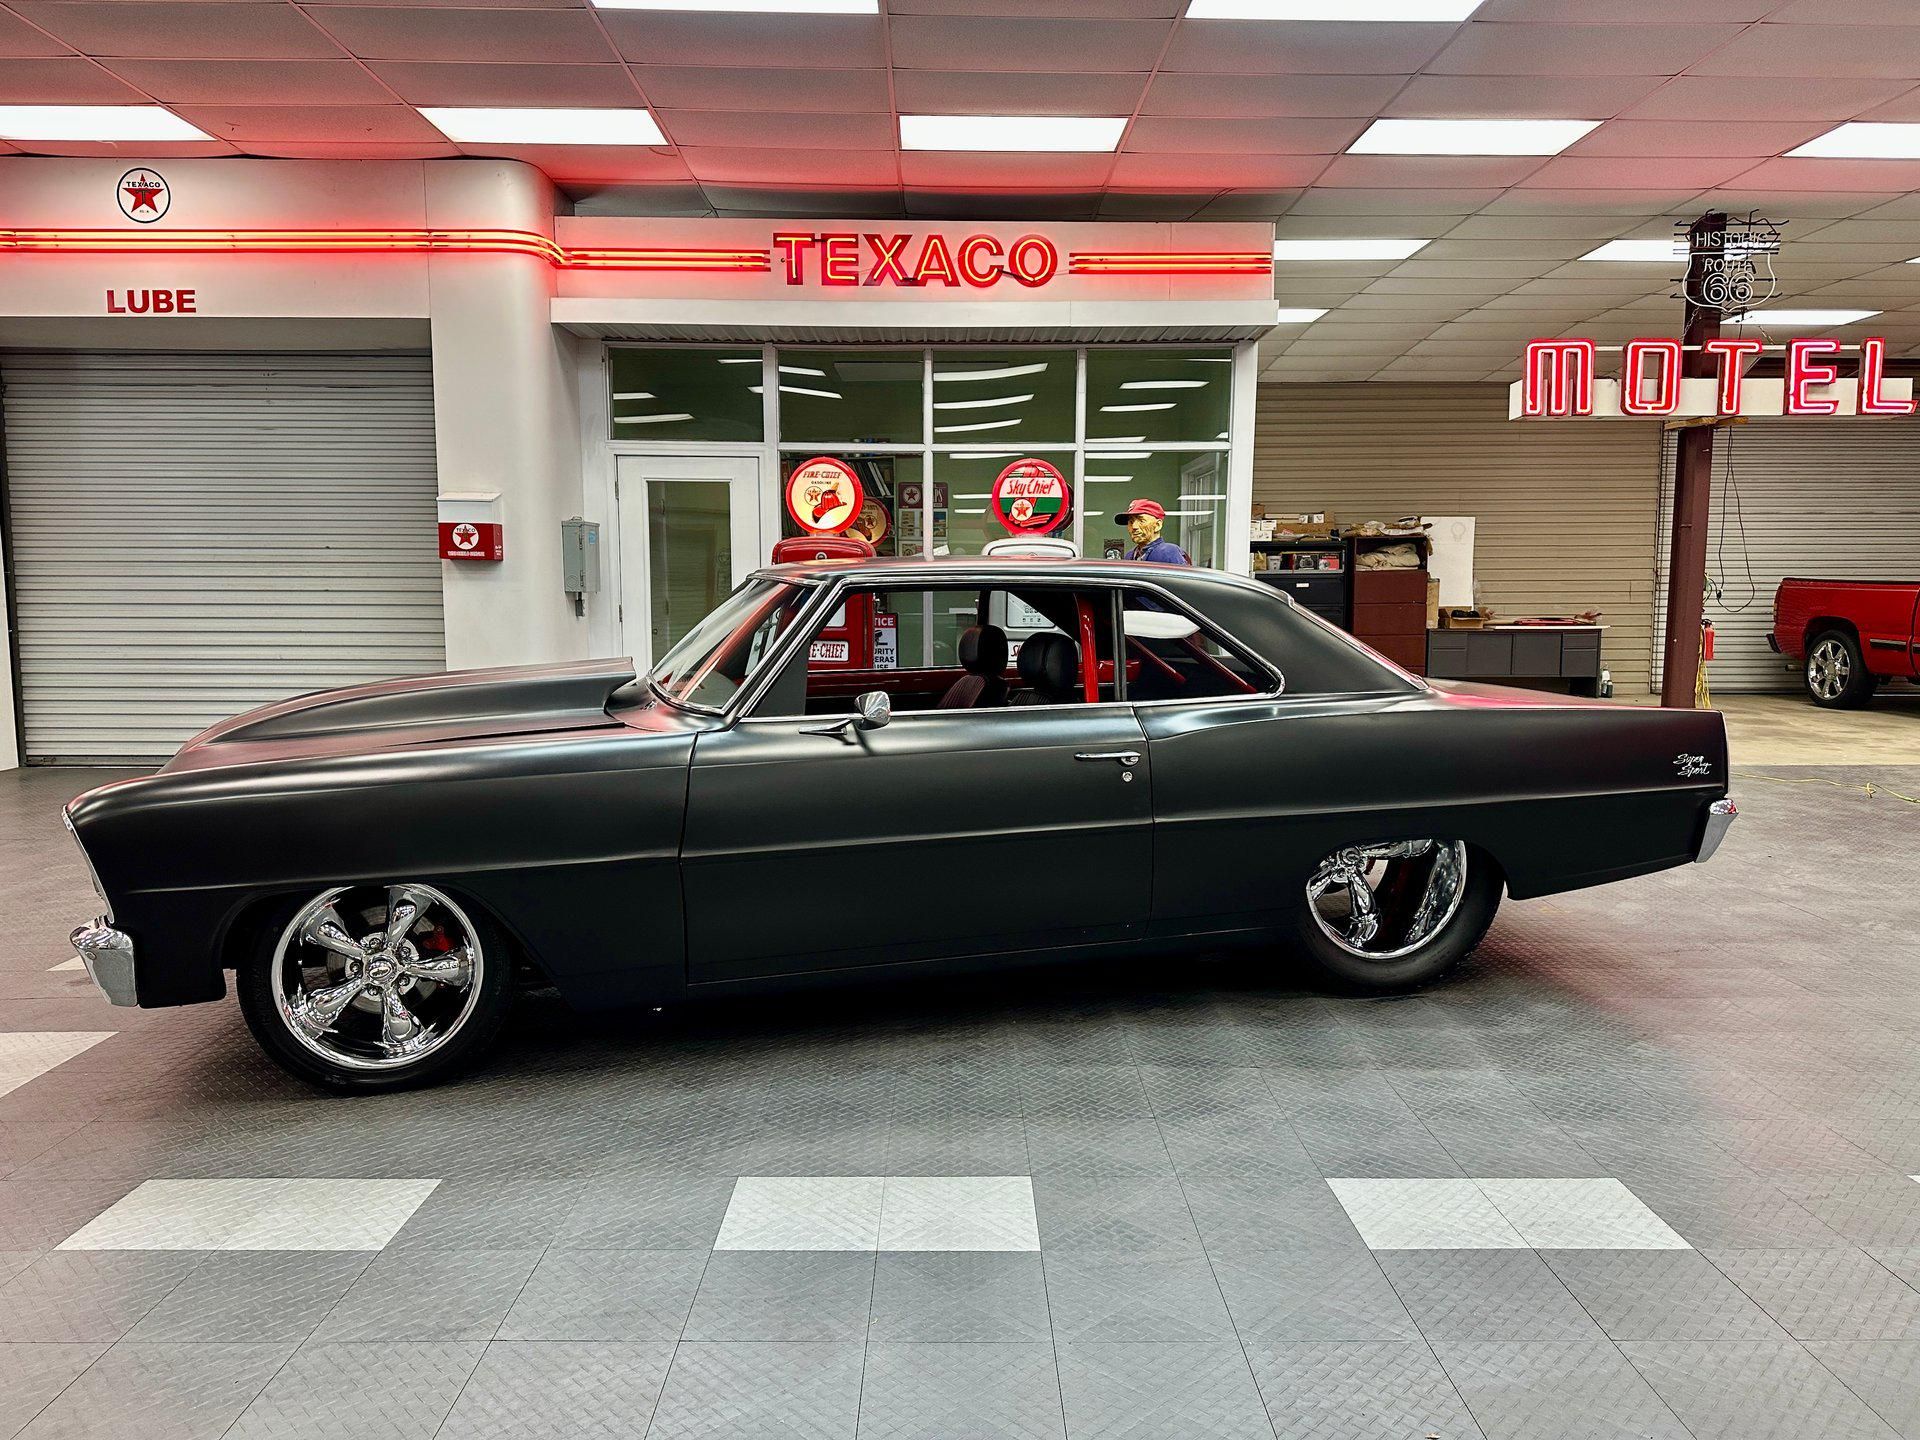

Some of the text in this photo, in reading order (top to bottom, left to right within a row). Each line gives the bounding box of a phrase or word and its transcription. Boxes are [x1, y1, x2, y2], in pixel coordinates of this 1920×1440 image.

[1695, 231, 1768, 247] HISTORIC
[773, 232, 1058, 288] TEXACO
[1704, 258, 1752, 273] ROUTE
[1703, 272, 1755, 304] 66
[106, 290, 197, 313] LUBE
[1522, 337, 1918, 416] MOTEL
[1006, 479, 1055, 496] Sky Chief
[874, 617, 894, 626] TICE
[1672, 753, 1704, 766] Super
[1677, 762, 1713, 777] Sport
